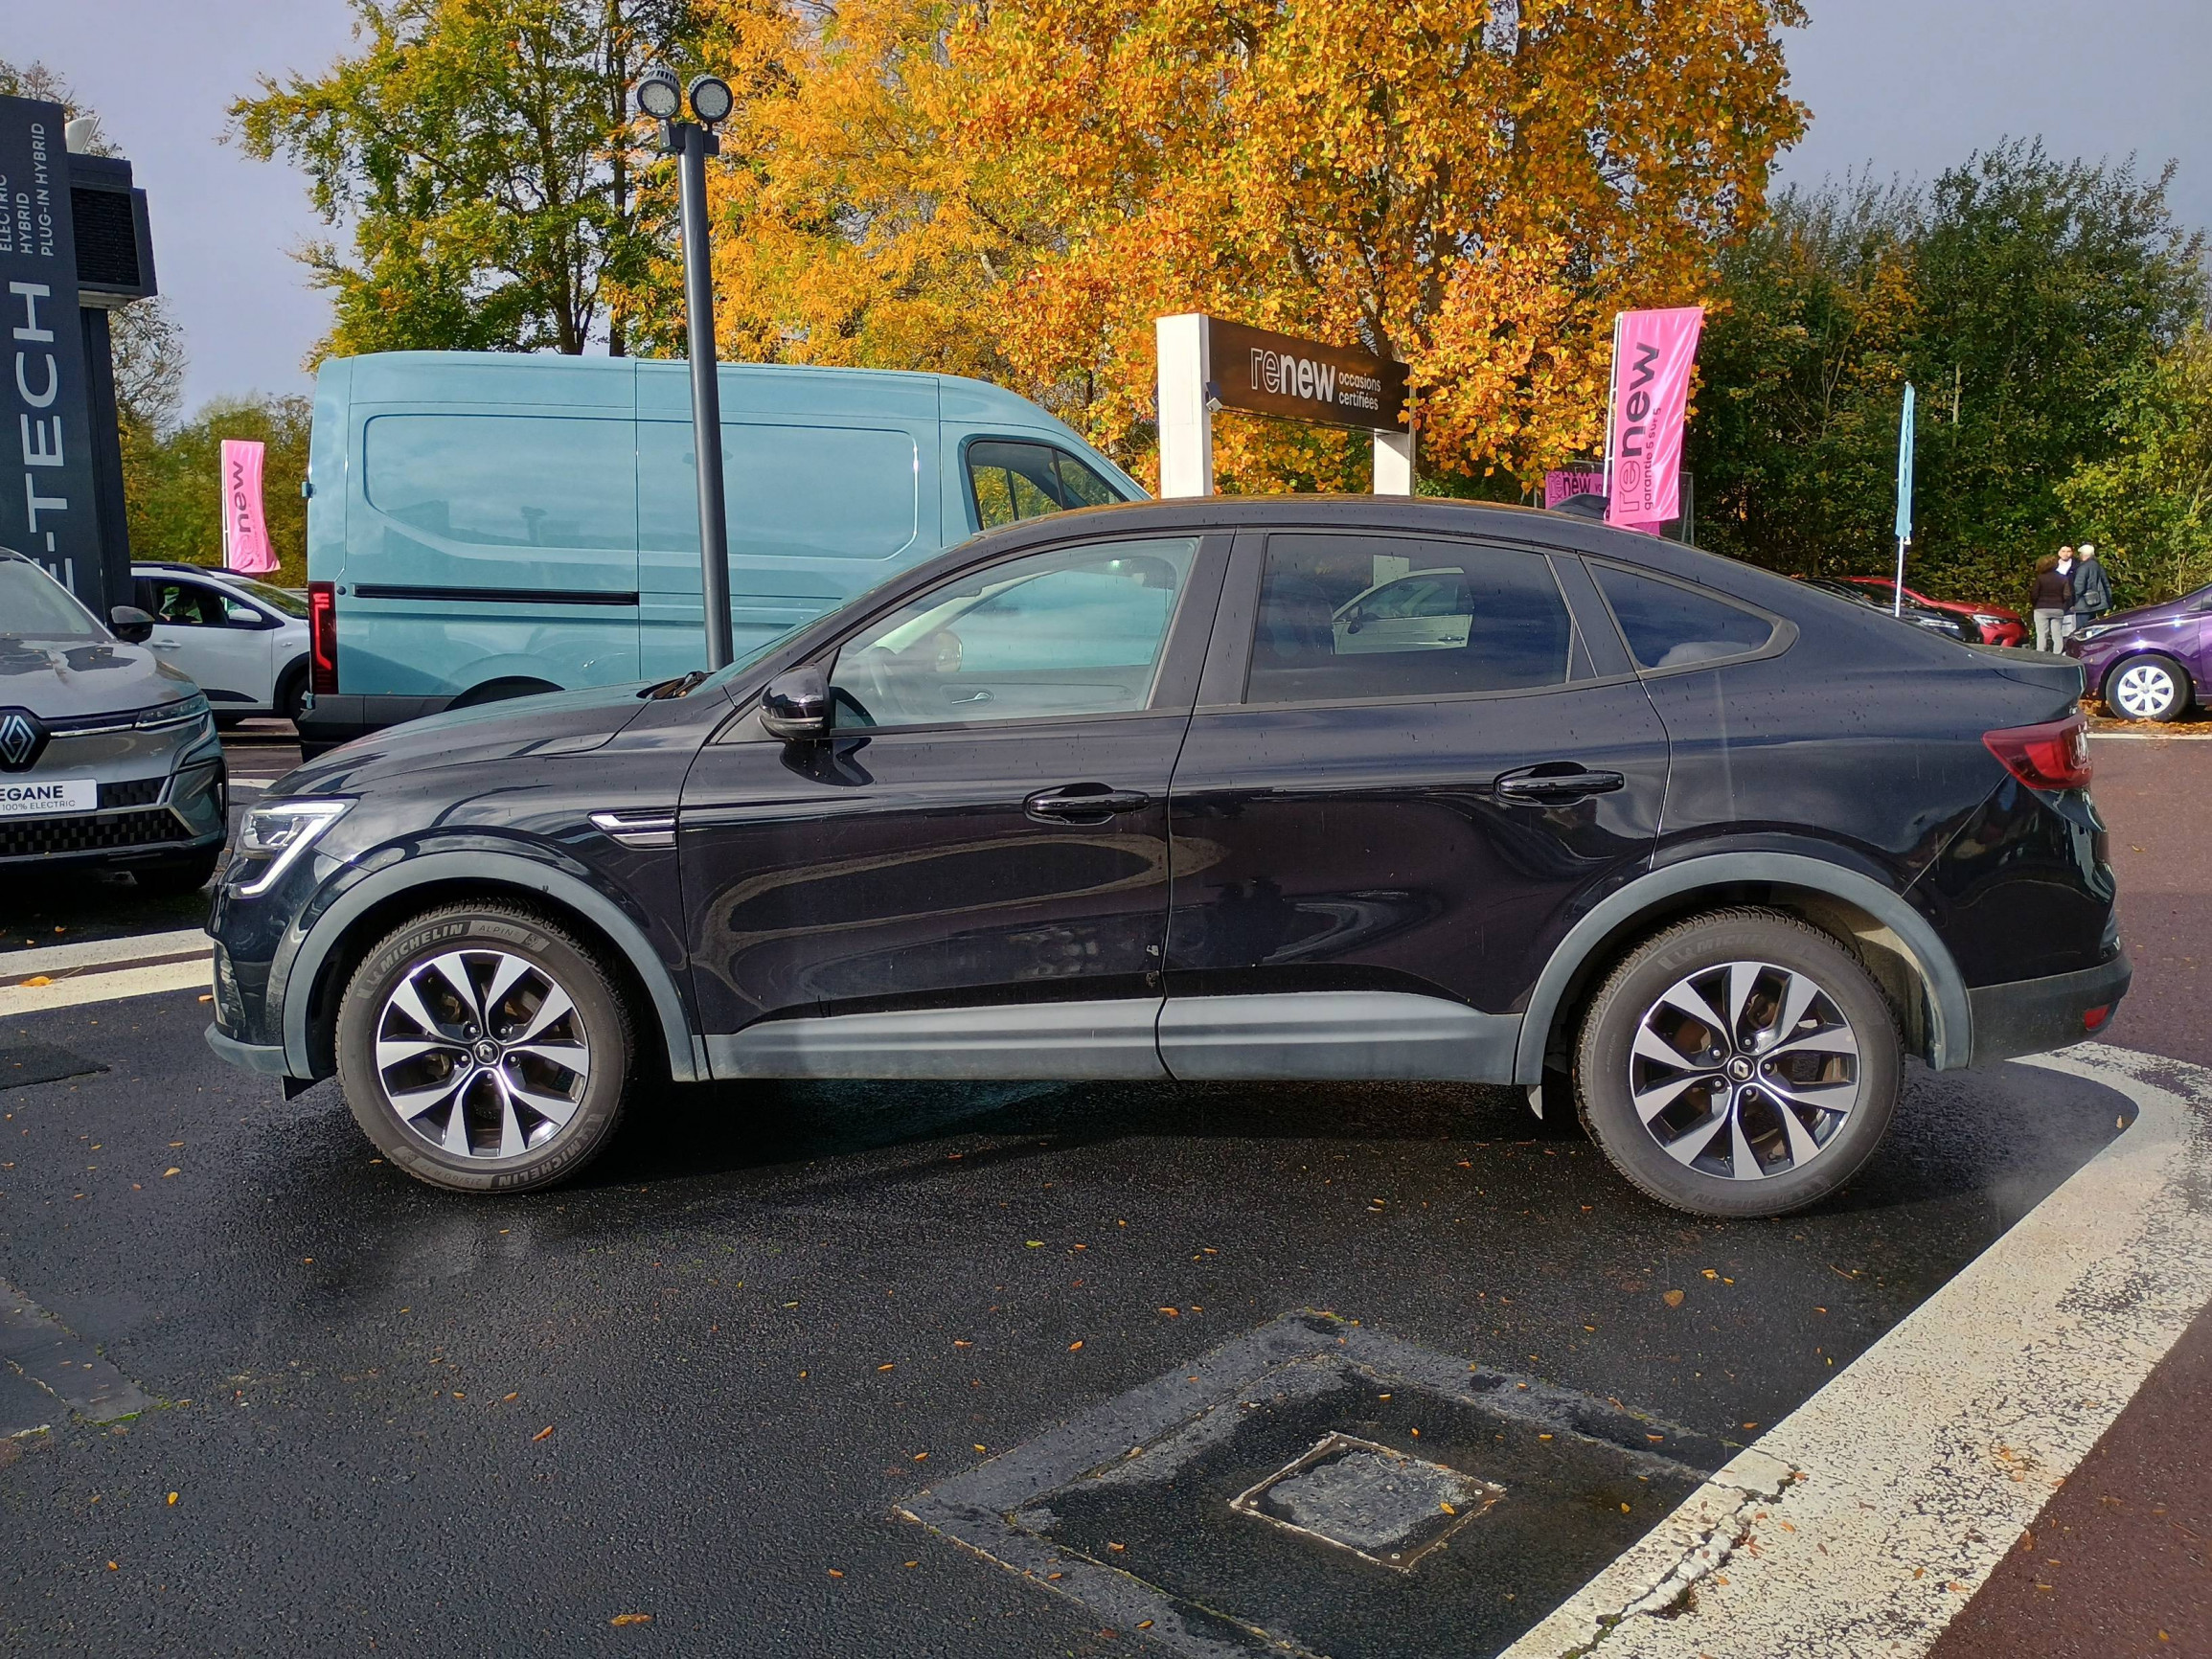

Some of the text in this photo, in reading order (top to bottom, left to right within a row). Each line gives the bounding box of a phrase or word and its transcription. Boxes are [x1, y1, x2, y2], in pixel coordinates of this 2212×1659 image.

[31, 123, 55, 257] PLUG-IN HYBRID
[15, 192, 34, 254] HYBRID
[1250, 347, 1336, 403] renew
[1338, 372, 1381, 393] occasions
[1338, 391, 1380, 411] certifiées
[1618, 341, 1660, 513] renew
[1644, 453, 1653, 511] garantie
[1649, 419, 1657, 438] sur
[30, 800, 76, 809] ELECTRIC
[380, 922, 514, 973] MICHELIN ALPIN
[497, 1140, 582, 1188] MICHELIN
